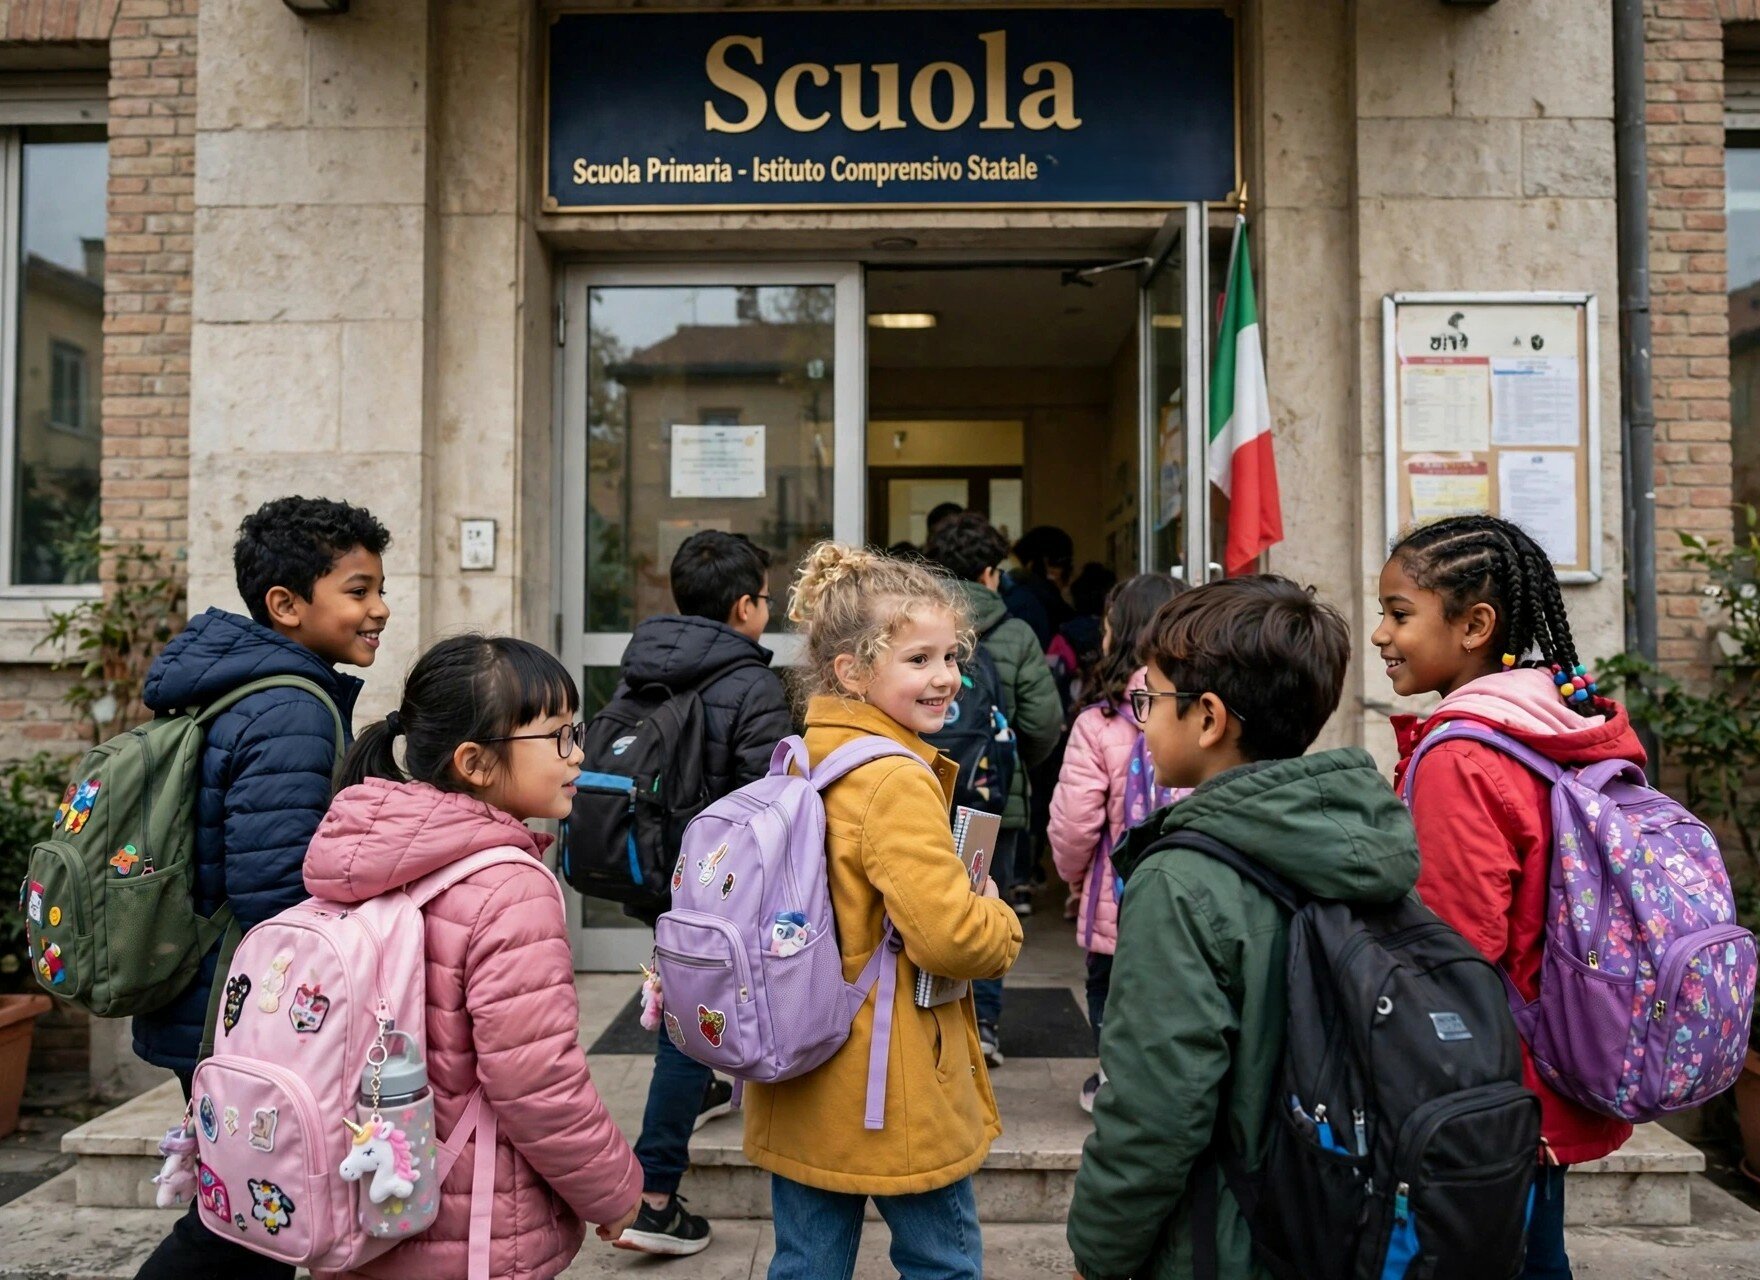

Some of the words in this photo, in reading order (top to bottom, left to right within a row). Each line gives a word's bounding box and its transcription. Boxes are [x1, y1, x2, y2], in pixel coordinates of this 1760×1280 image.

[704, 30, 1083, 134] Scuola
[573, 157, 641, 185] Scuola
[646, 156, 733, 184] Primaria
[752, 156, 826, 183] Istituto
[830, 155, 963, 187] Comprensivo
[967, 154, 1038, 181] Statale
